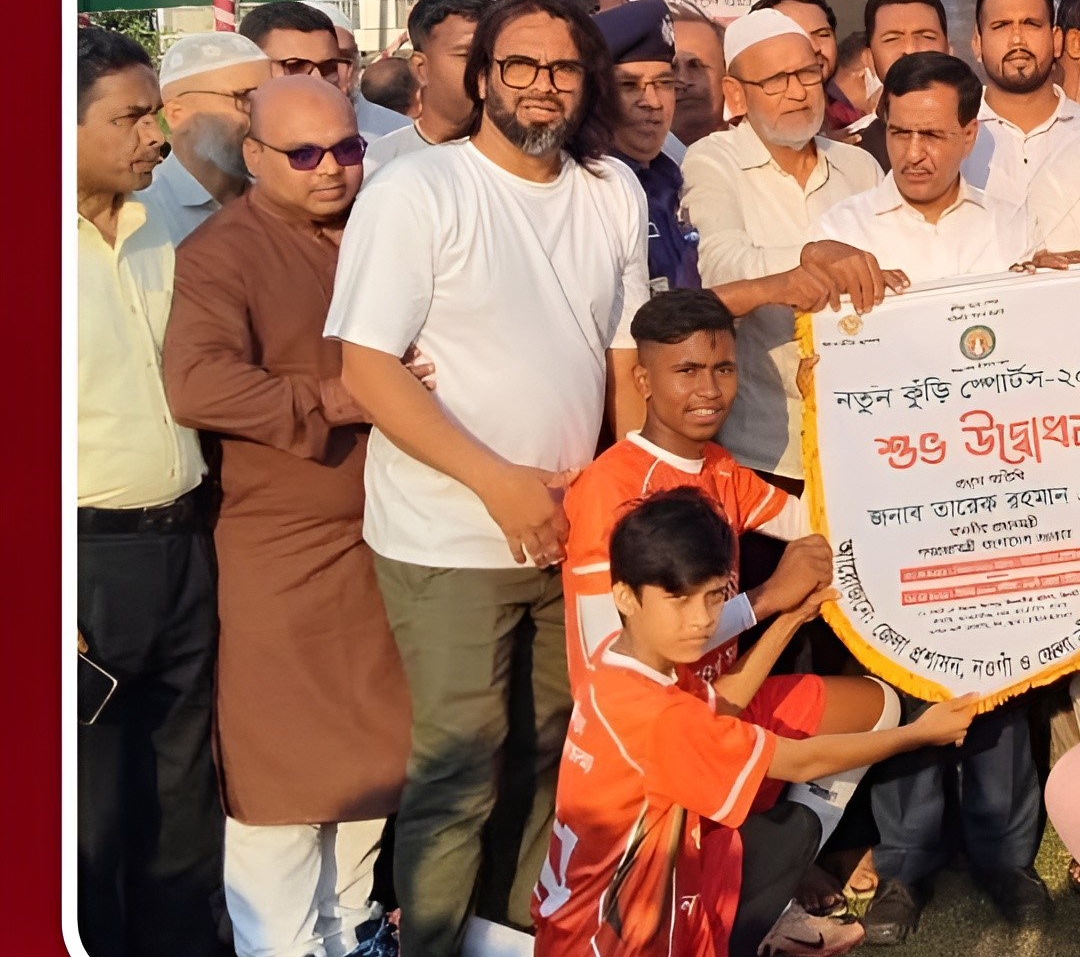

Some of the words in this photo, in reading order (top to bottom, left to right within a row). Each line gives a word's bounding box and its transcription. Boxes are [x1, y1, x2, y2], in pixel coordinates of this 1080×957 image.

[834, 385, 893, 414] নতুন
[902, 377, 952, 410] কুঁড়ি
[874, 432, 946, 469] শুভ
[867, 505, 923, 526] জনাব
[931, 494, 997, 518] তারেক
[1020, 655, 1031, 670] ও
